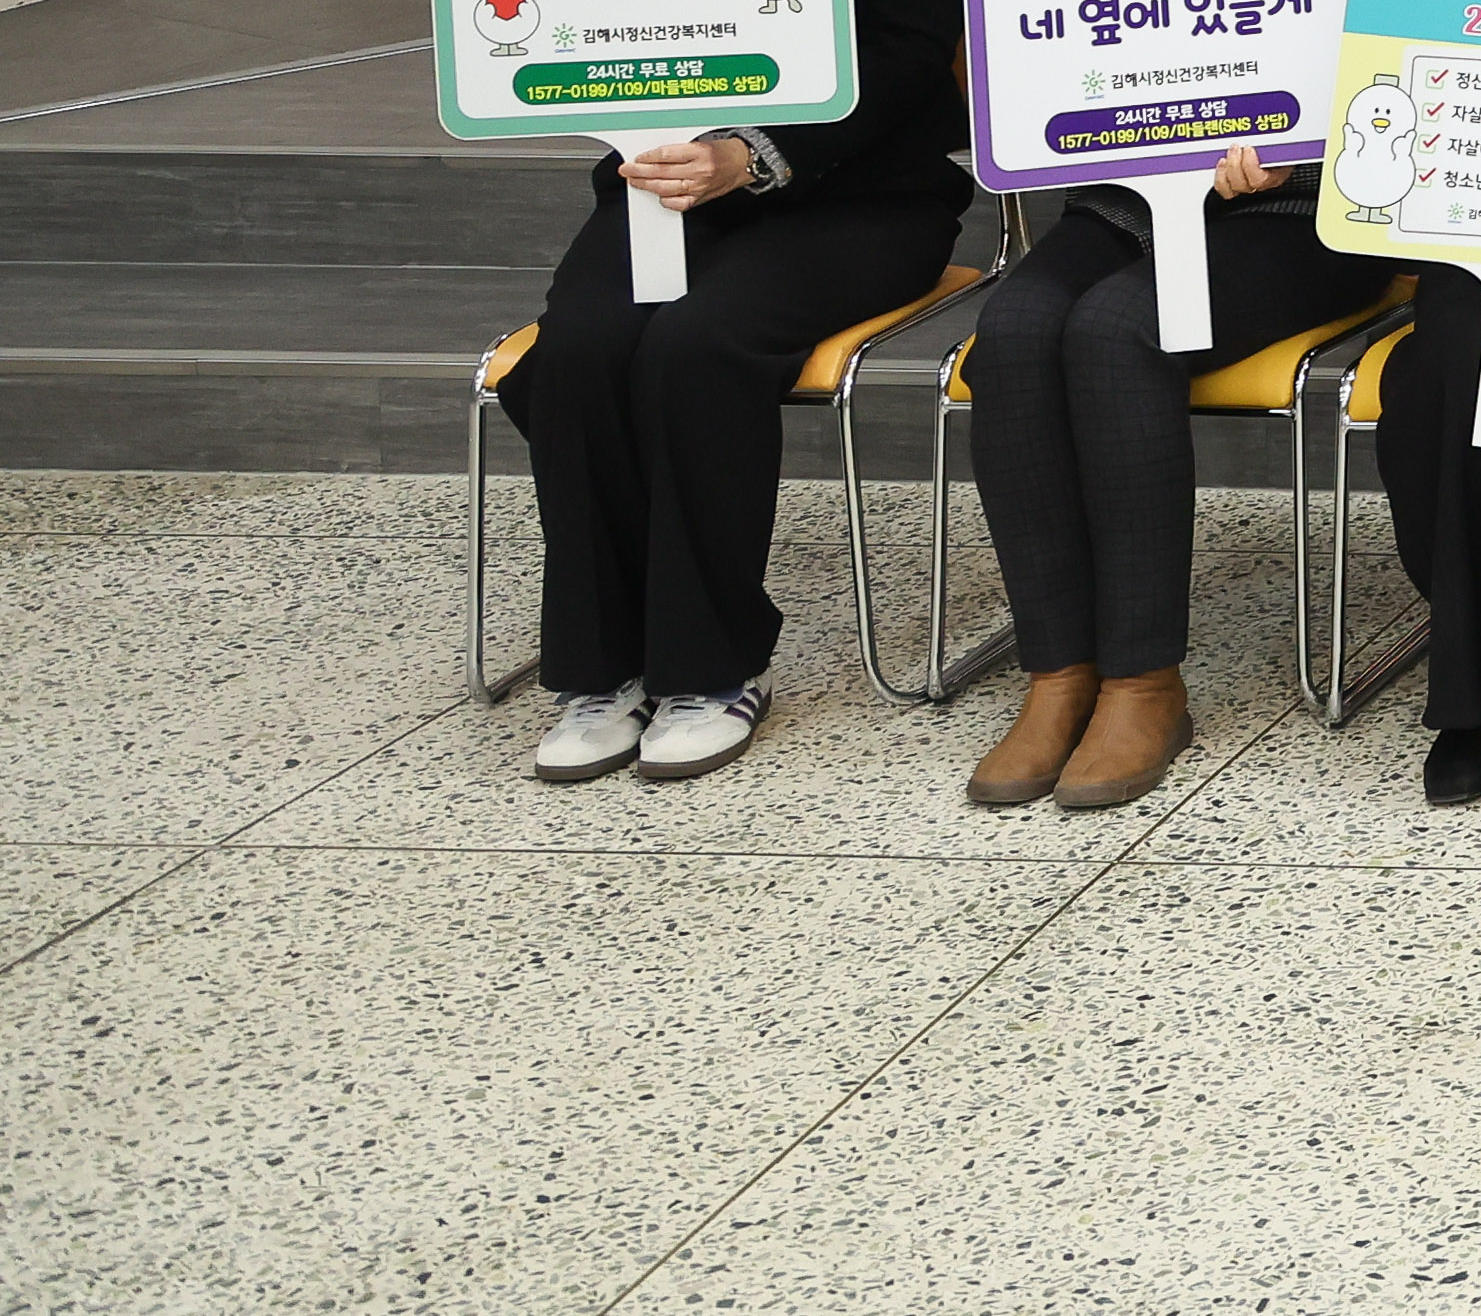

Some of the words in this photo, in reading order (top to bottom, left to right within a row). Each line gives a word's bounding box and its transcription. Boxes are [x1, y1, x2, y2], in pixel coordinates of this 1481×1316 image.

[582, 22, 737, 44] 김해시정신건강복지센터
[1019, 8, 1065, 40] 네
[586, 63, 638, 80] 24시간
[639, 61, 670, 77] 무료
[673, 58, 704, 77] 상담
[1111, 60, 1259, 89] 김해시정신건강복지센터
[526, 78, 727, 101] 1577-0199/109/마들랜(SNS
[733, 75, 768, 94] 상담)
[1114, 107, 1162, 125] 24시간
[1165, 104, 1195, 121] 무료
[1198, 100, 1228, 118] 상담
[1057, 116, 1251, 150] 1577-0199/109/마들랜(SNS
[1255, 112, 1289, 131] 상담)
